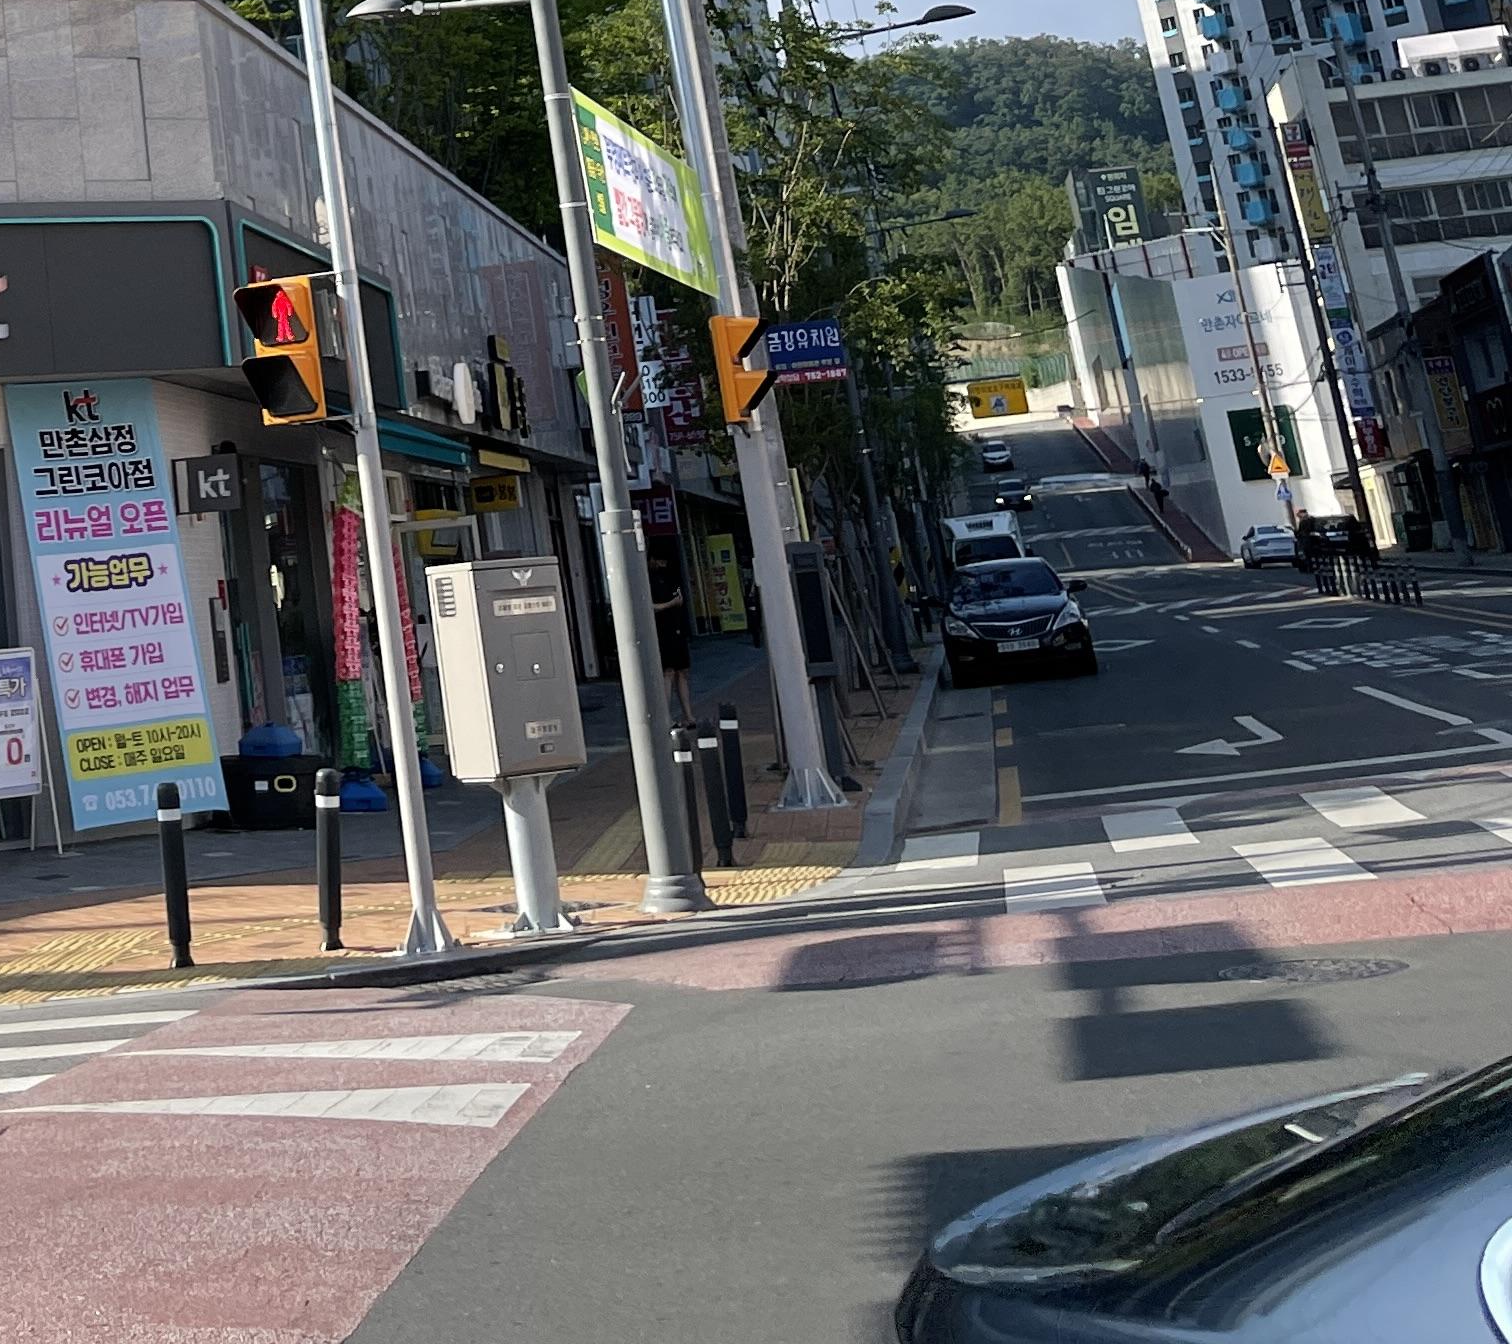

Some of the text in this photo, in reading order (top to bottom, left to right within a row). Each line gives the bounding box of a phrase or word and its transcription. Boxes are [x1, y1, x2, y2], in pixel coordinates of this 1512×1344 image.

[768, 326, 840, 352] 금강유치원
[63, 389, 100, 423] kt
[39, 424, 137, 459] 만촌삼정
[33, 459, 156, 496] 그린코아점
[198, 468, 231, 498] kt
[35, 500, 170, 542] 리뉴얼 오픈
[66, 555, 152, 590] 가능업무
[73, 602, 184, 635] 인터넷/TV가입
[80, 642, 164, 672] 휴대폰 가입
[124, 680, 159, 705] 해지
[161, 675, 195, 700] 업무
[7, 737, 23, 765] 0
[76, 736, 106, 753] OPEN
[79, 755, 116, 772] CLOSE
[105, 776, 217, 811] 053.70110
